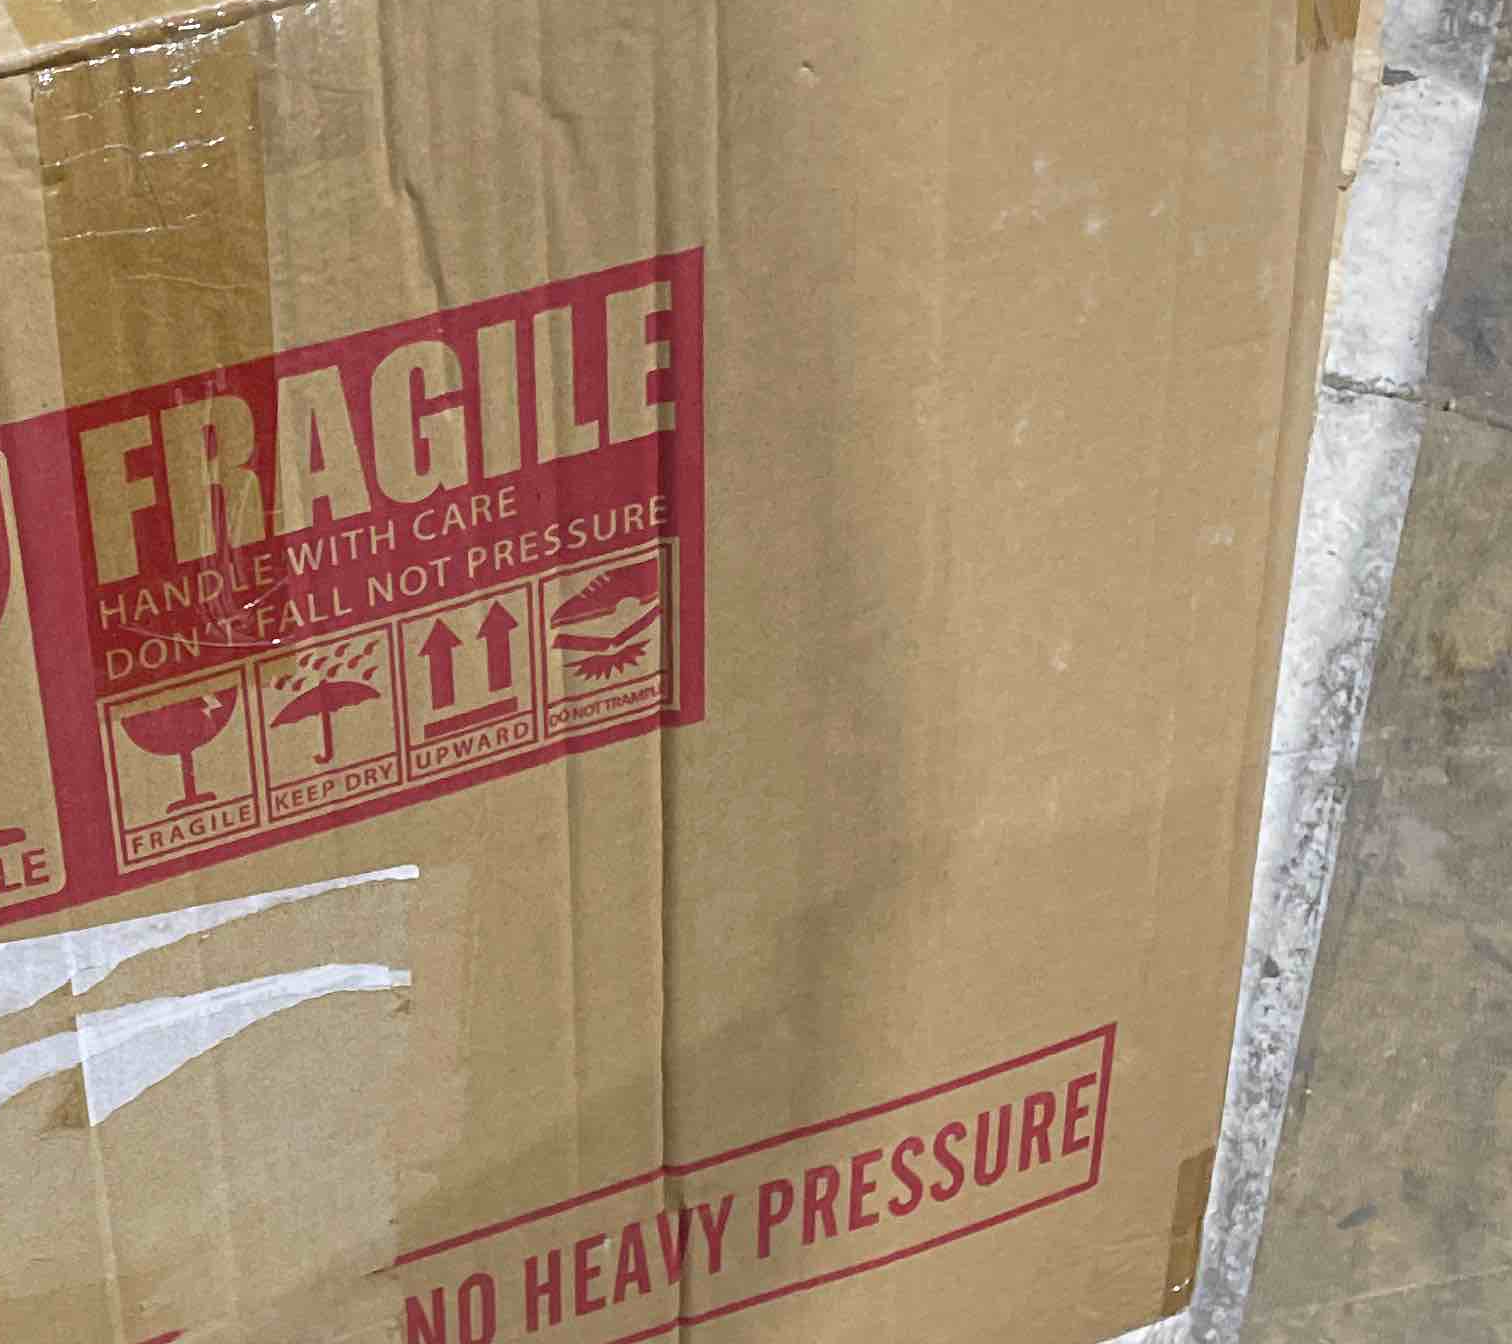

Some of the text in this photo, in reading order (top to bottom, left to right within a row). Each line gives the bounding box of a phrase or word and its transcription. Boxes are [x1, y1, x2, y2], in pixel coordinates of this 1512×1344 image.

[79, 281, 676, 586] FRAGILE
[99, 485, 519, 630] HANDLE WITH CARE
[255, 586, 352, 638] FALL
[367, 556, 452, 608] NOT
[467, 494, 669, 579] PRESSURE
[414, 720, 531, 771] UPWARD
[550, 706, 570, 727] DO
[573, 700, 602, 720] NOT
[130, 803, 253, 855] FRAGILE
[272, 761, 395, 812] KEEP DRY
[523, 1193, 737, 1335] HEAVY
[755, 1070, 1098, 1260] PRESSURE
